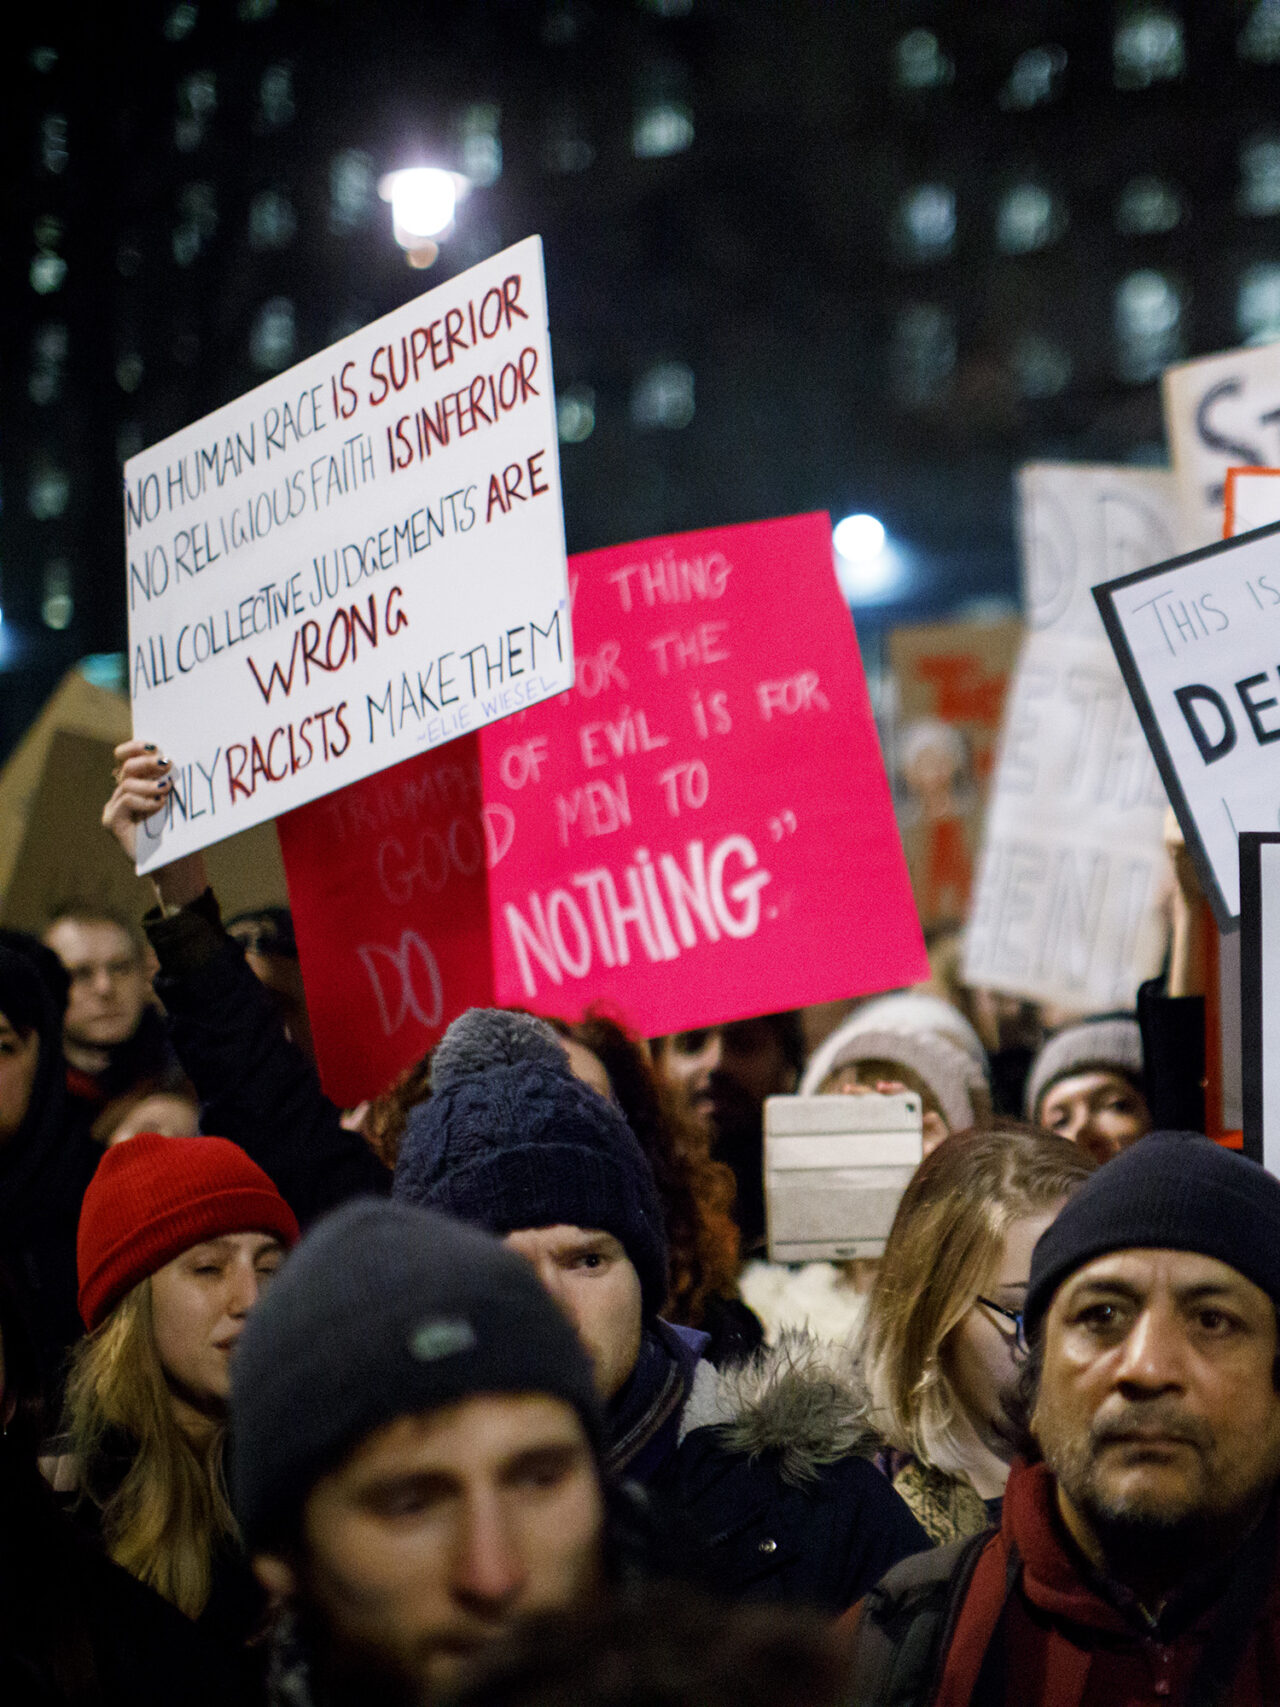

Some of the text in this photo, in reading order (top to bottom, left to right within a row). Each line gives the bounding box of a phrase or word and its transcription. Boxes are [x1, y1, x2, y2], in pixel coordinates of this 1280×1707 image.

[125, 274, 529, 535] NO HUMAN RACE IS SUPERIOR
[130, 346, 541, 611] NO RELIGIOUS FAITH IS INFERIOR
[133, 635, 174, 698] ALL
[176, 571, 305, 673] COLLECTIVE
[309, 485, 478, 607] JUDGEMENTS
[485, 450, 549, 524] ARE
[1133, 589, 1229, 658] THIS
[246, 586, 409, 704] WRONG
[481, 675, 558, 720] WIESEL
[575, 620, 730, 698] OR THE
[225, 701, 351, 802] RACISTS
[367, 651, 459, 744] MAKE
[459, 609, 563, 699] THEM
[501, 735, 549, 790] OF
[756, 670, 830, 722] FOR
[376, 760, 709, 905] GOOD MEN TO
[357, 929, 444, 1037] DO
